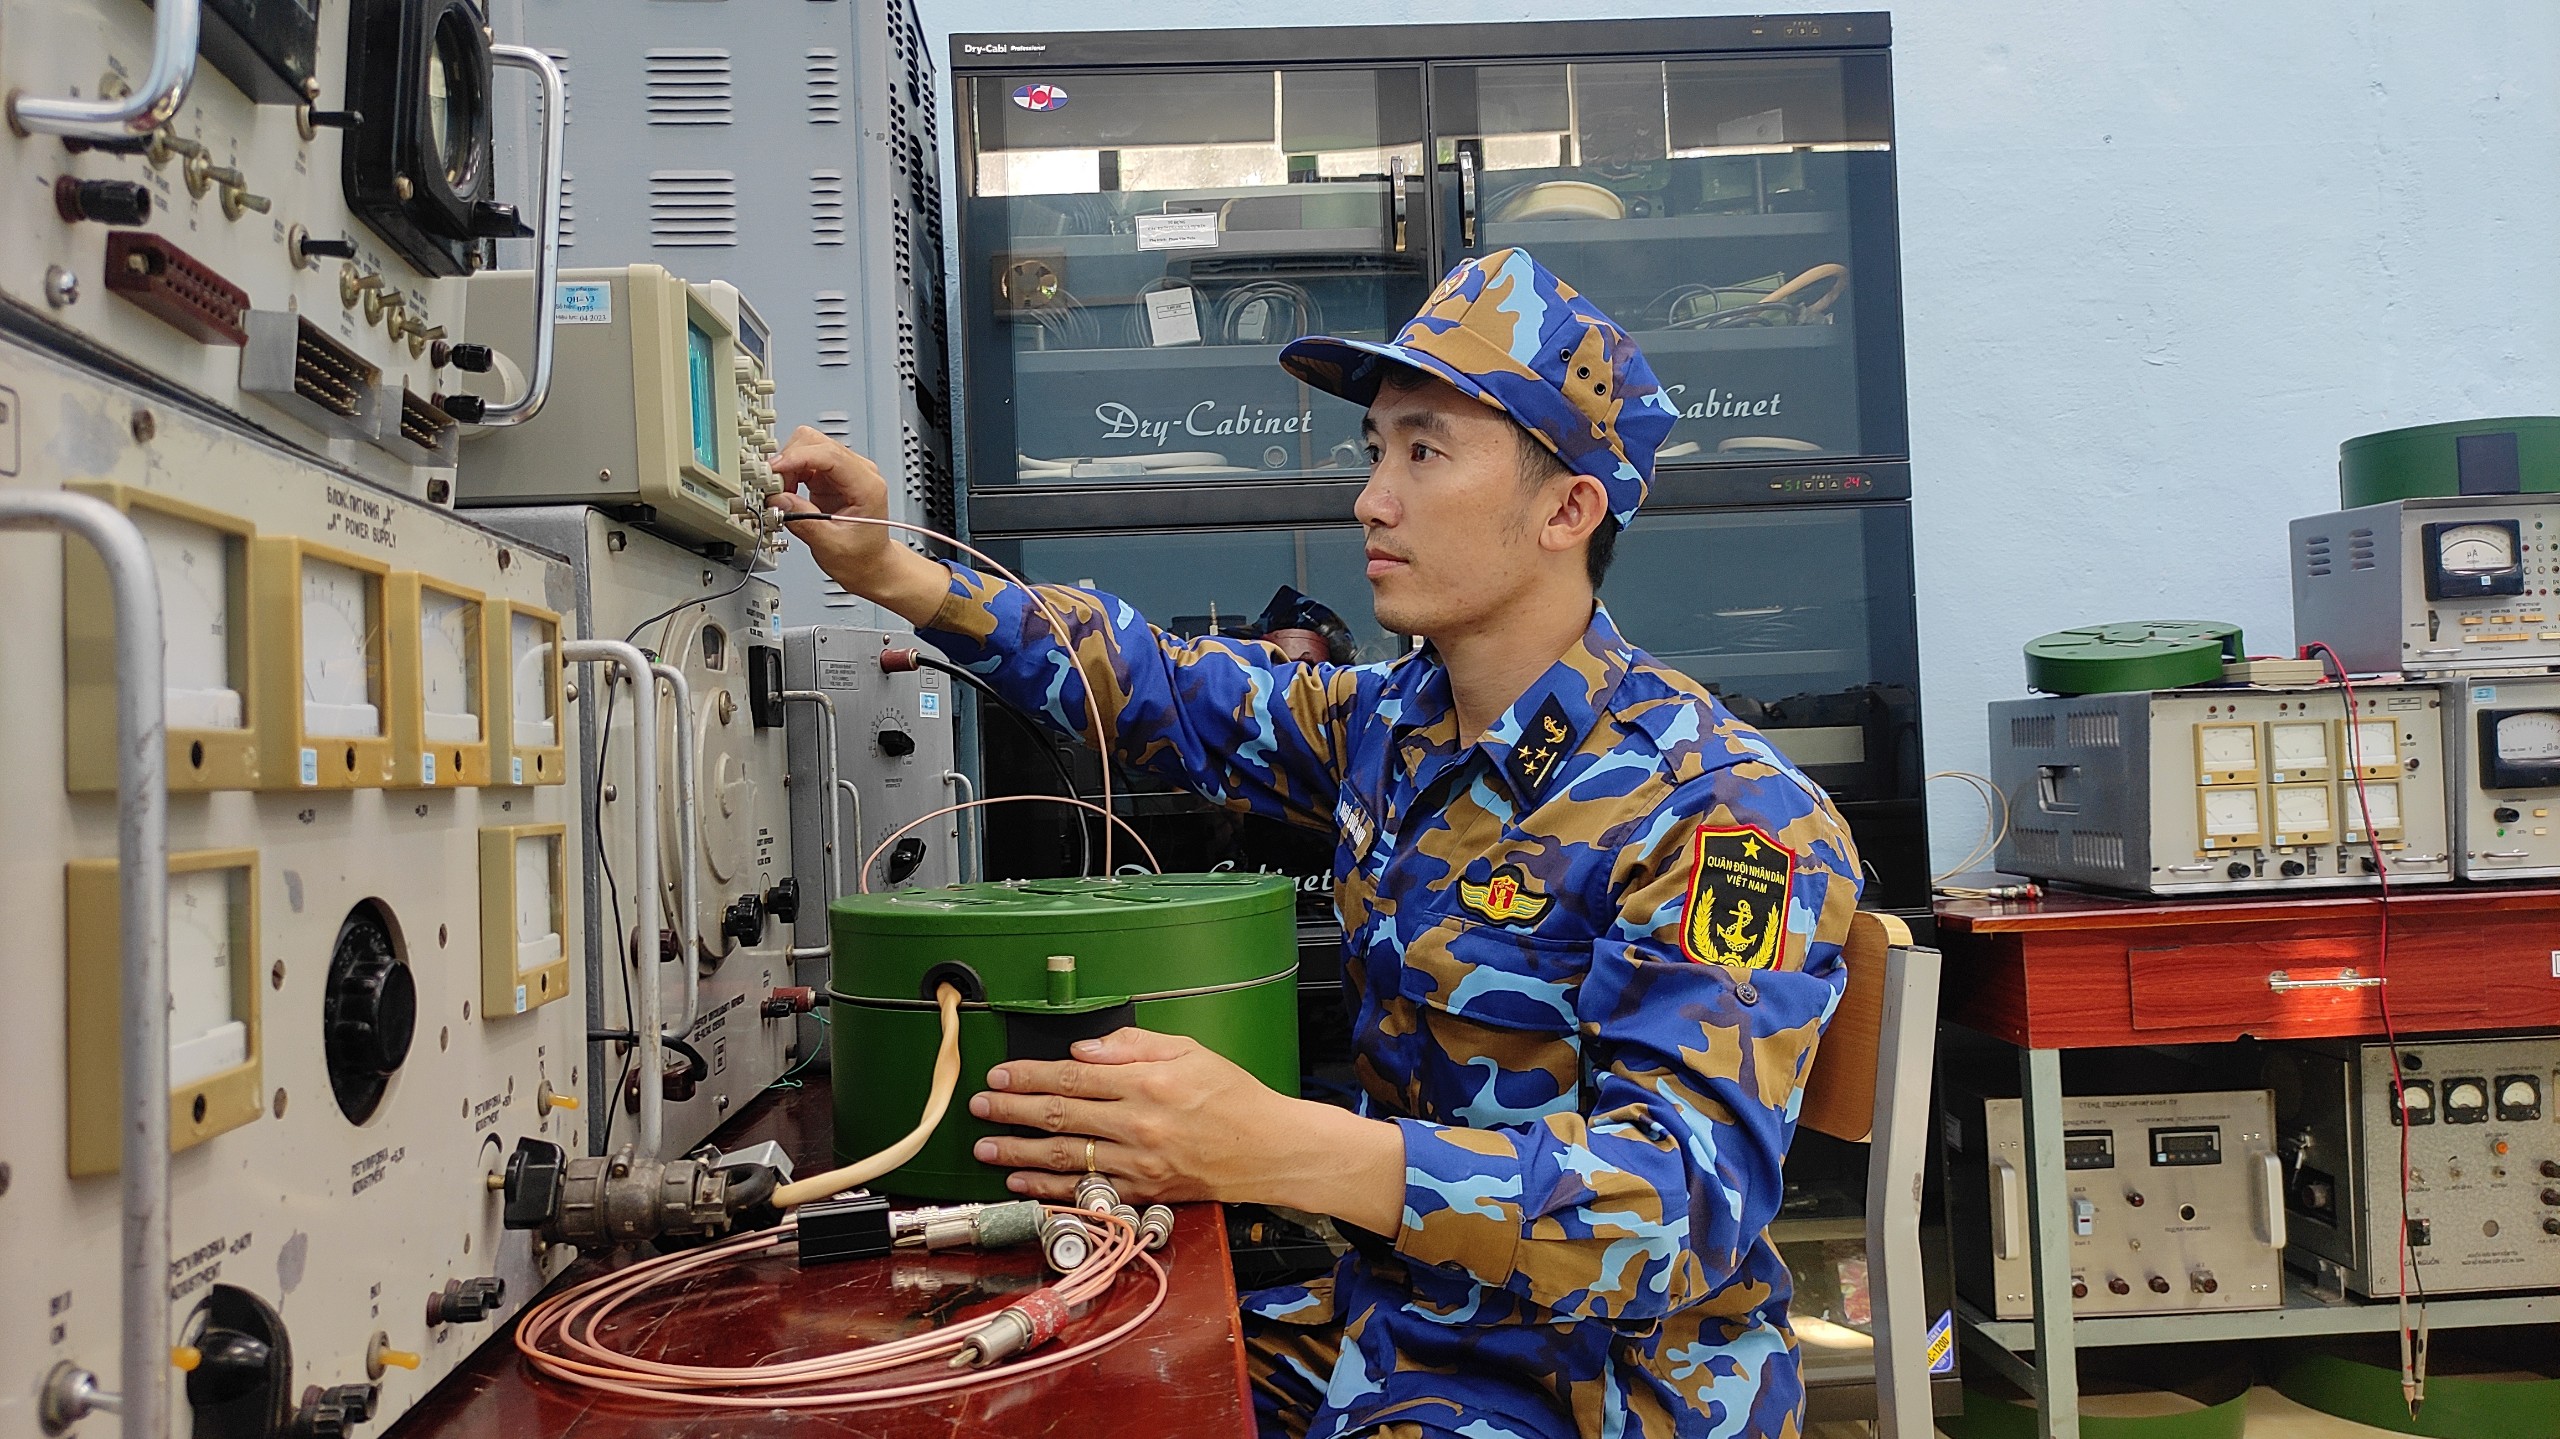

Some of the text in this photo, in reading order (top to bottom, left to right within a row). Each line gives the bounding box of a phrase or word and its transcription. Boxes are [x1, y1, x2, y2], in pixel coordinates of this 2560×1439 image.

[964, 44, 1008, 54] Dry-Cabi
[1095, 400, 1313, 447] Dry-Cabinet
[1843, 476, 1860, 488] 24
[345, 517, 369, 540] POWER
[372, 527, 397, 549] SUPPLY
[1707, 856, 1785, 886] QUÂN ĐỘI NHÂN DÂN
[1726, 873, 1768, 894] VIỆT NAM
